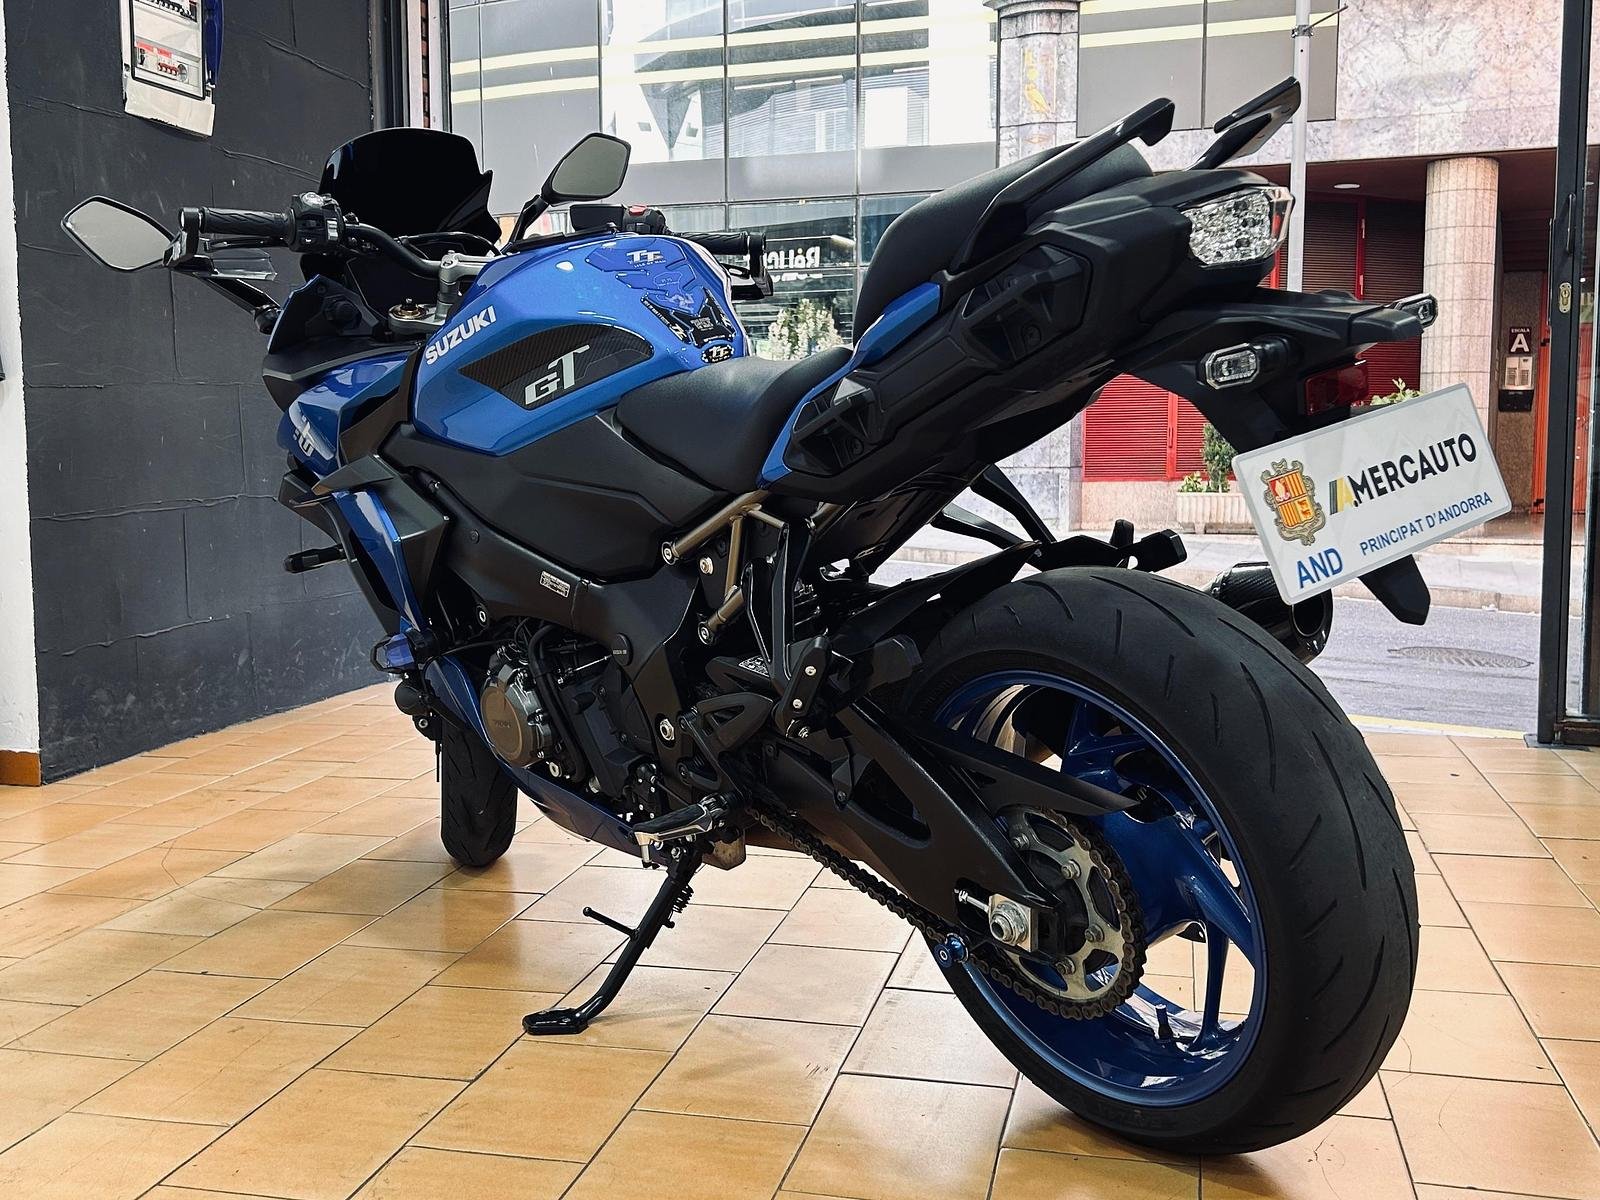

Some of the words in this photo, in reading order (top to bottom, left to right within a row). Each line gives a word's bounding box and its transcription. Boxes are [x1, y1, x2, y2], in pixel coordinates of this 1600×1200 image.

[425, 305, 497, 365] SUZUKI
[1510, 333, 1530, 353] A
[525, 344, 590, 405] GT
[1360, 518, 1424, 555] PRINCIPAT
[1425, 491, 1493, 529] D'ANDORRA
[1297, 547, 1343, 589] AND
